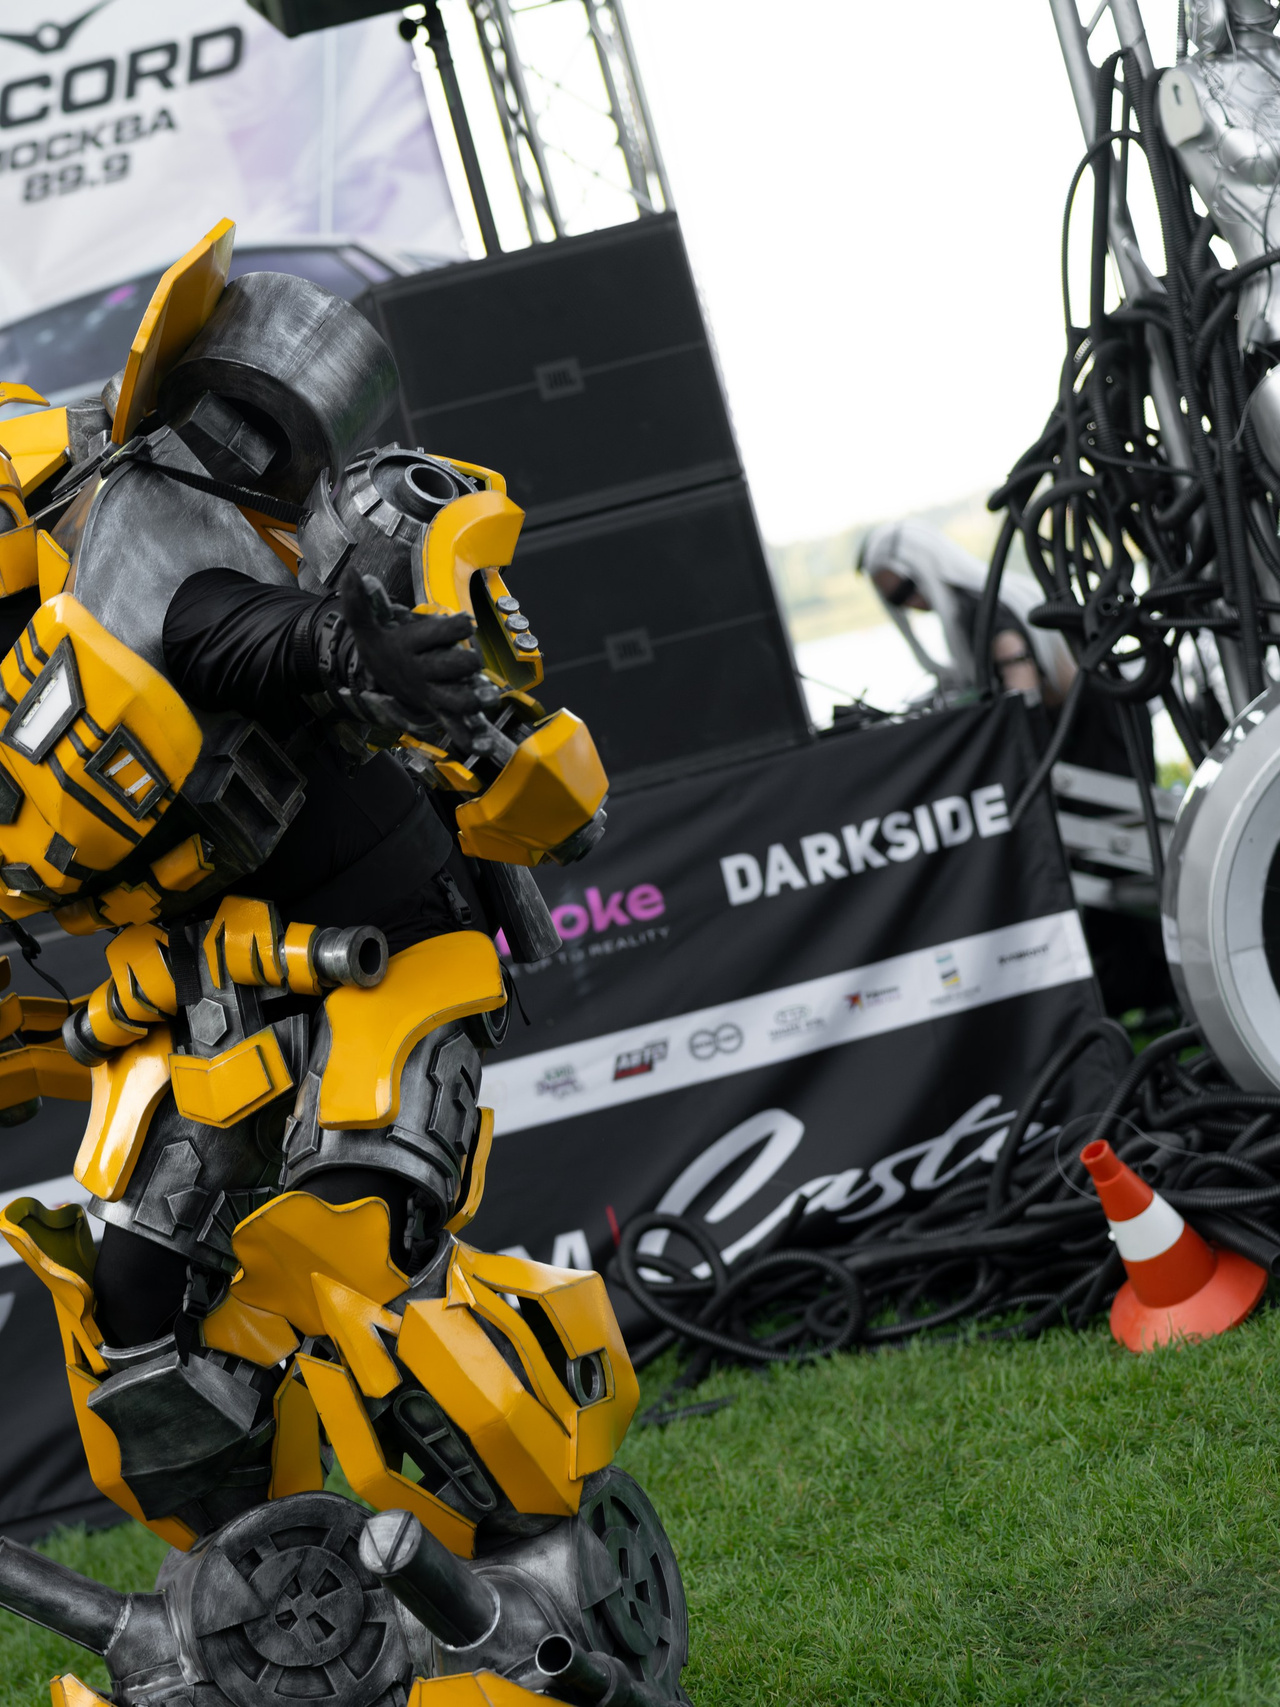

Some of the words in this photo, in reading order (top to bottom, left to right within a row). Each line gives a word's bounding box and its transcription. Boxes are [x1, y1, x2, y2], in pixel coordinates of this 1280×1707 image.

[22, 151, 133, 203] 89.9
[720, 783, 1013, 906] DARKSIDE
[588, 926, 670, 958] REALITY
